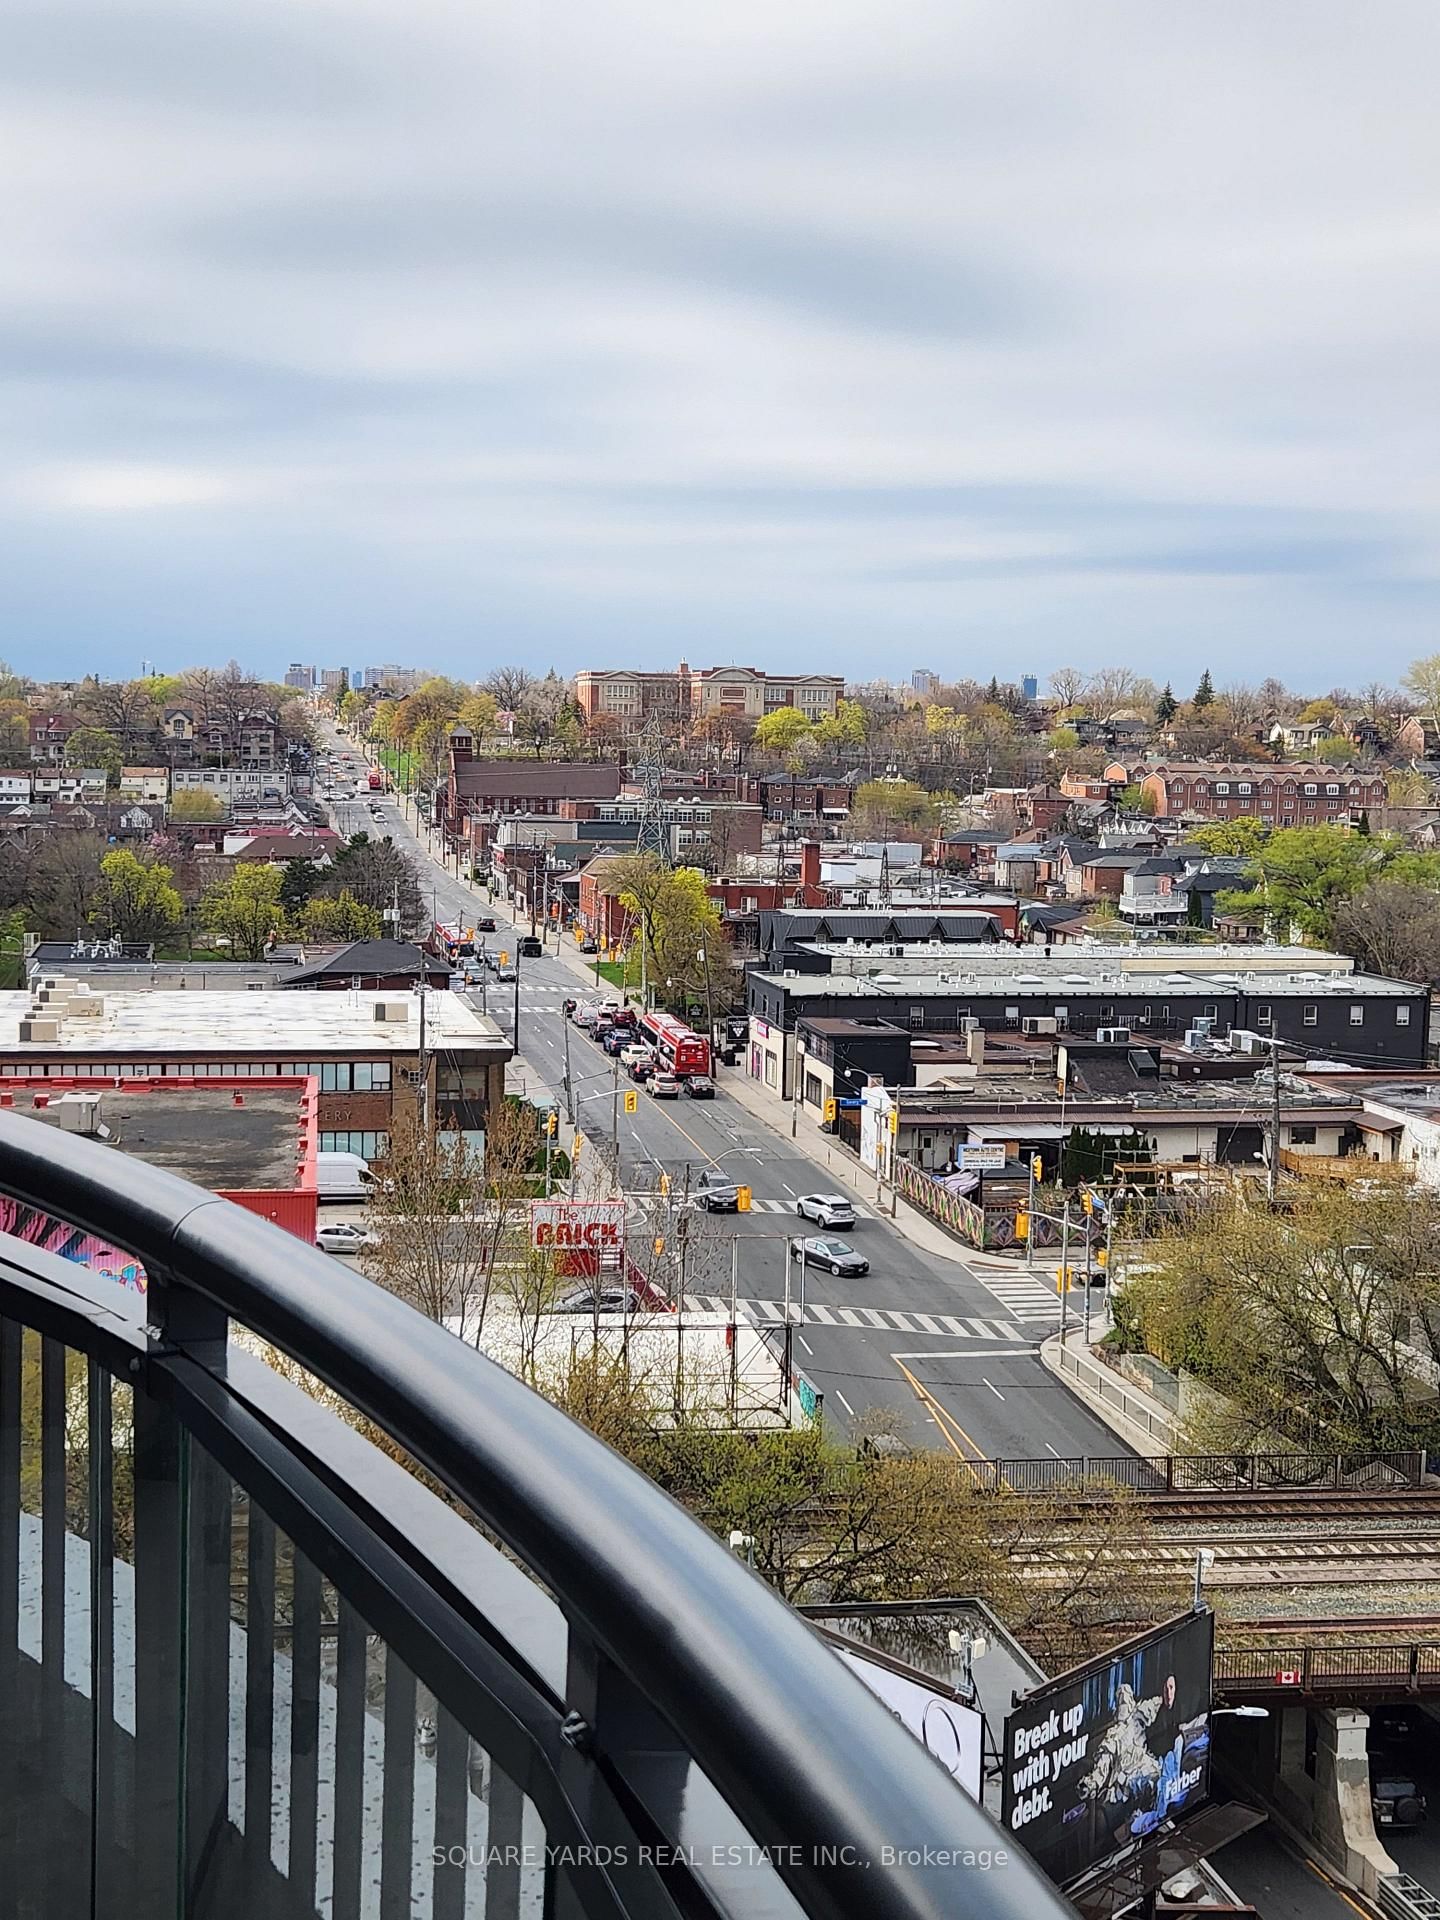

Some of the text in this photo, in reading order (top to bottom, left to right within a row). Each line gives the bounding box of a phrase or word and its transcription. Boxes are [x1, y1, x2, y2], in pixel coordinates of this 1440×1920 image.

[557, 1208, 578, 1221] The
[1014, 1703, 1084, 1760] Break up
[1012, 1733, 1089, 1795] with your
[1165, 1765, 1202, 1800] Farber
[1011, 1785, 1053, 1830] debt.
